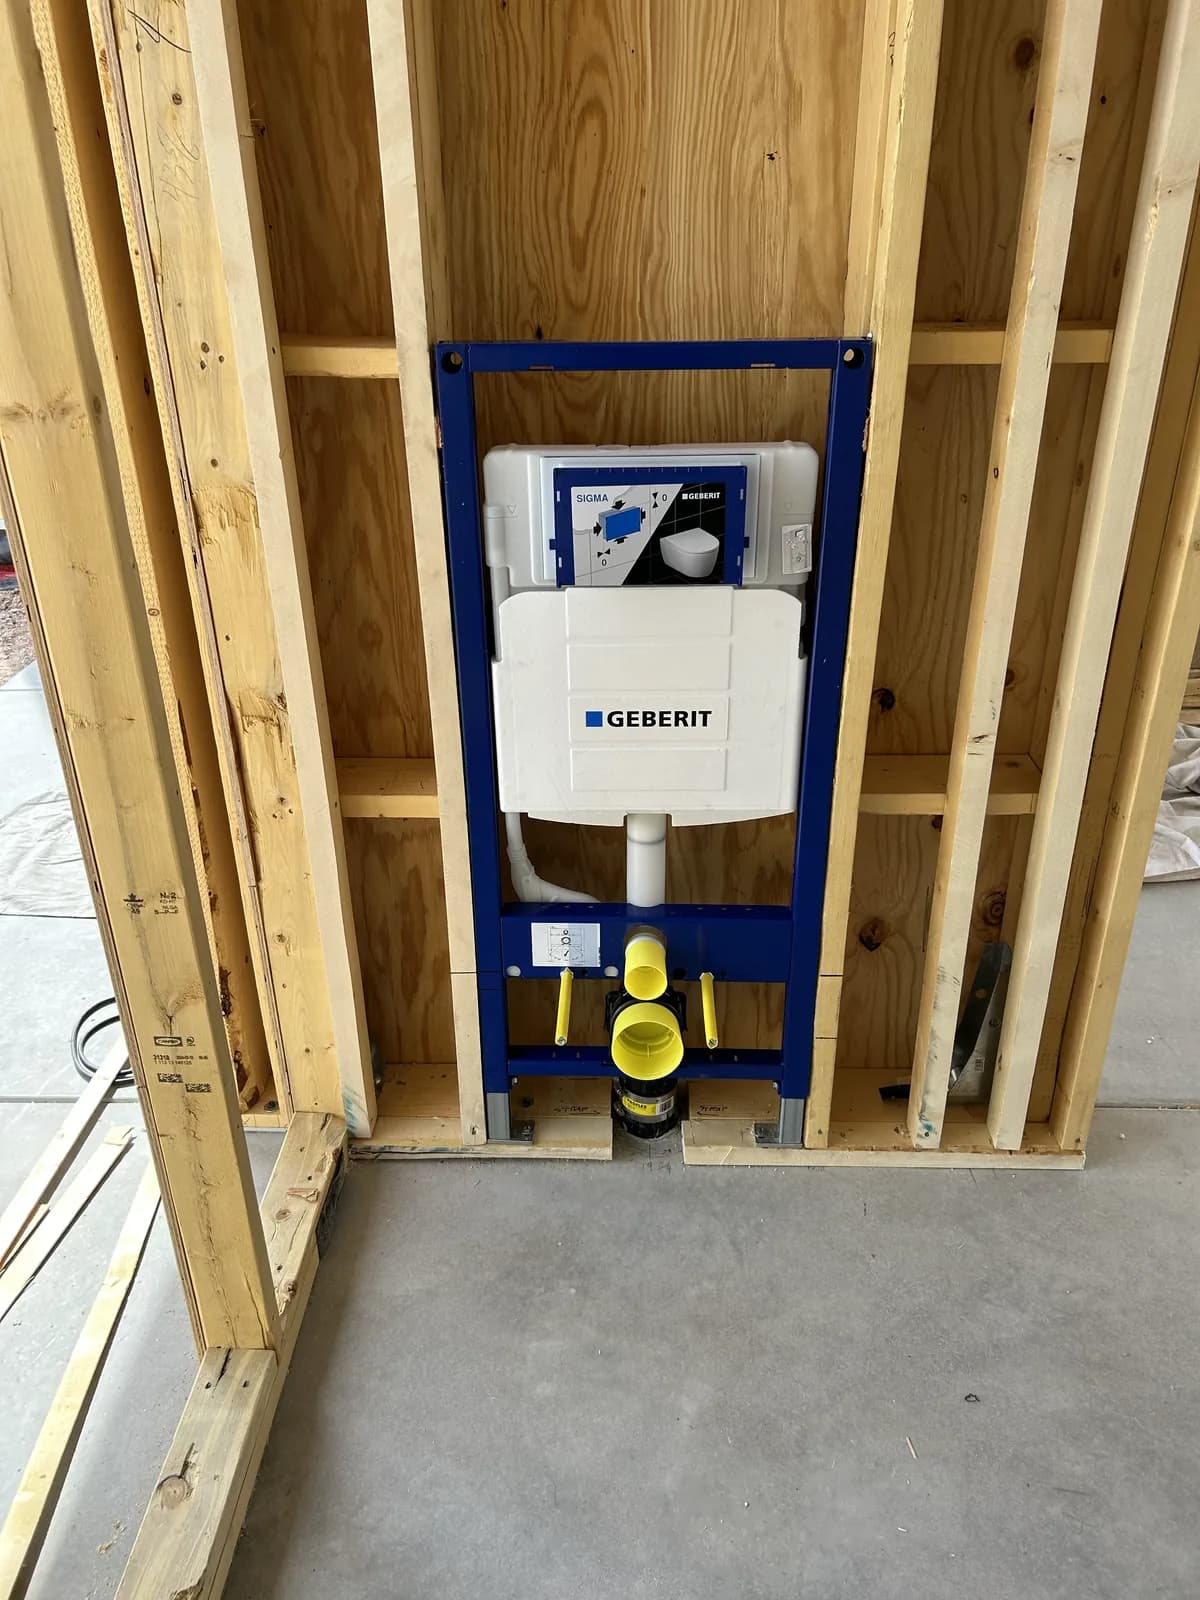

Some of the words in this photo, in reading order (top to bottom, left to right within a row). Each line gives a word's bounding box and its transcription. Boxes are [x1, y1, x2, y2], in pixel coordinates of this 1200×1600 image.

[576, 494, 608, 502] SIGMA
[688, 492, 721, 500] GEBERIT
[607, 711, 712, 727] GEBERIT
